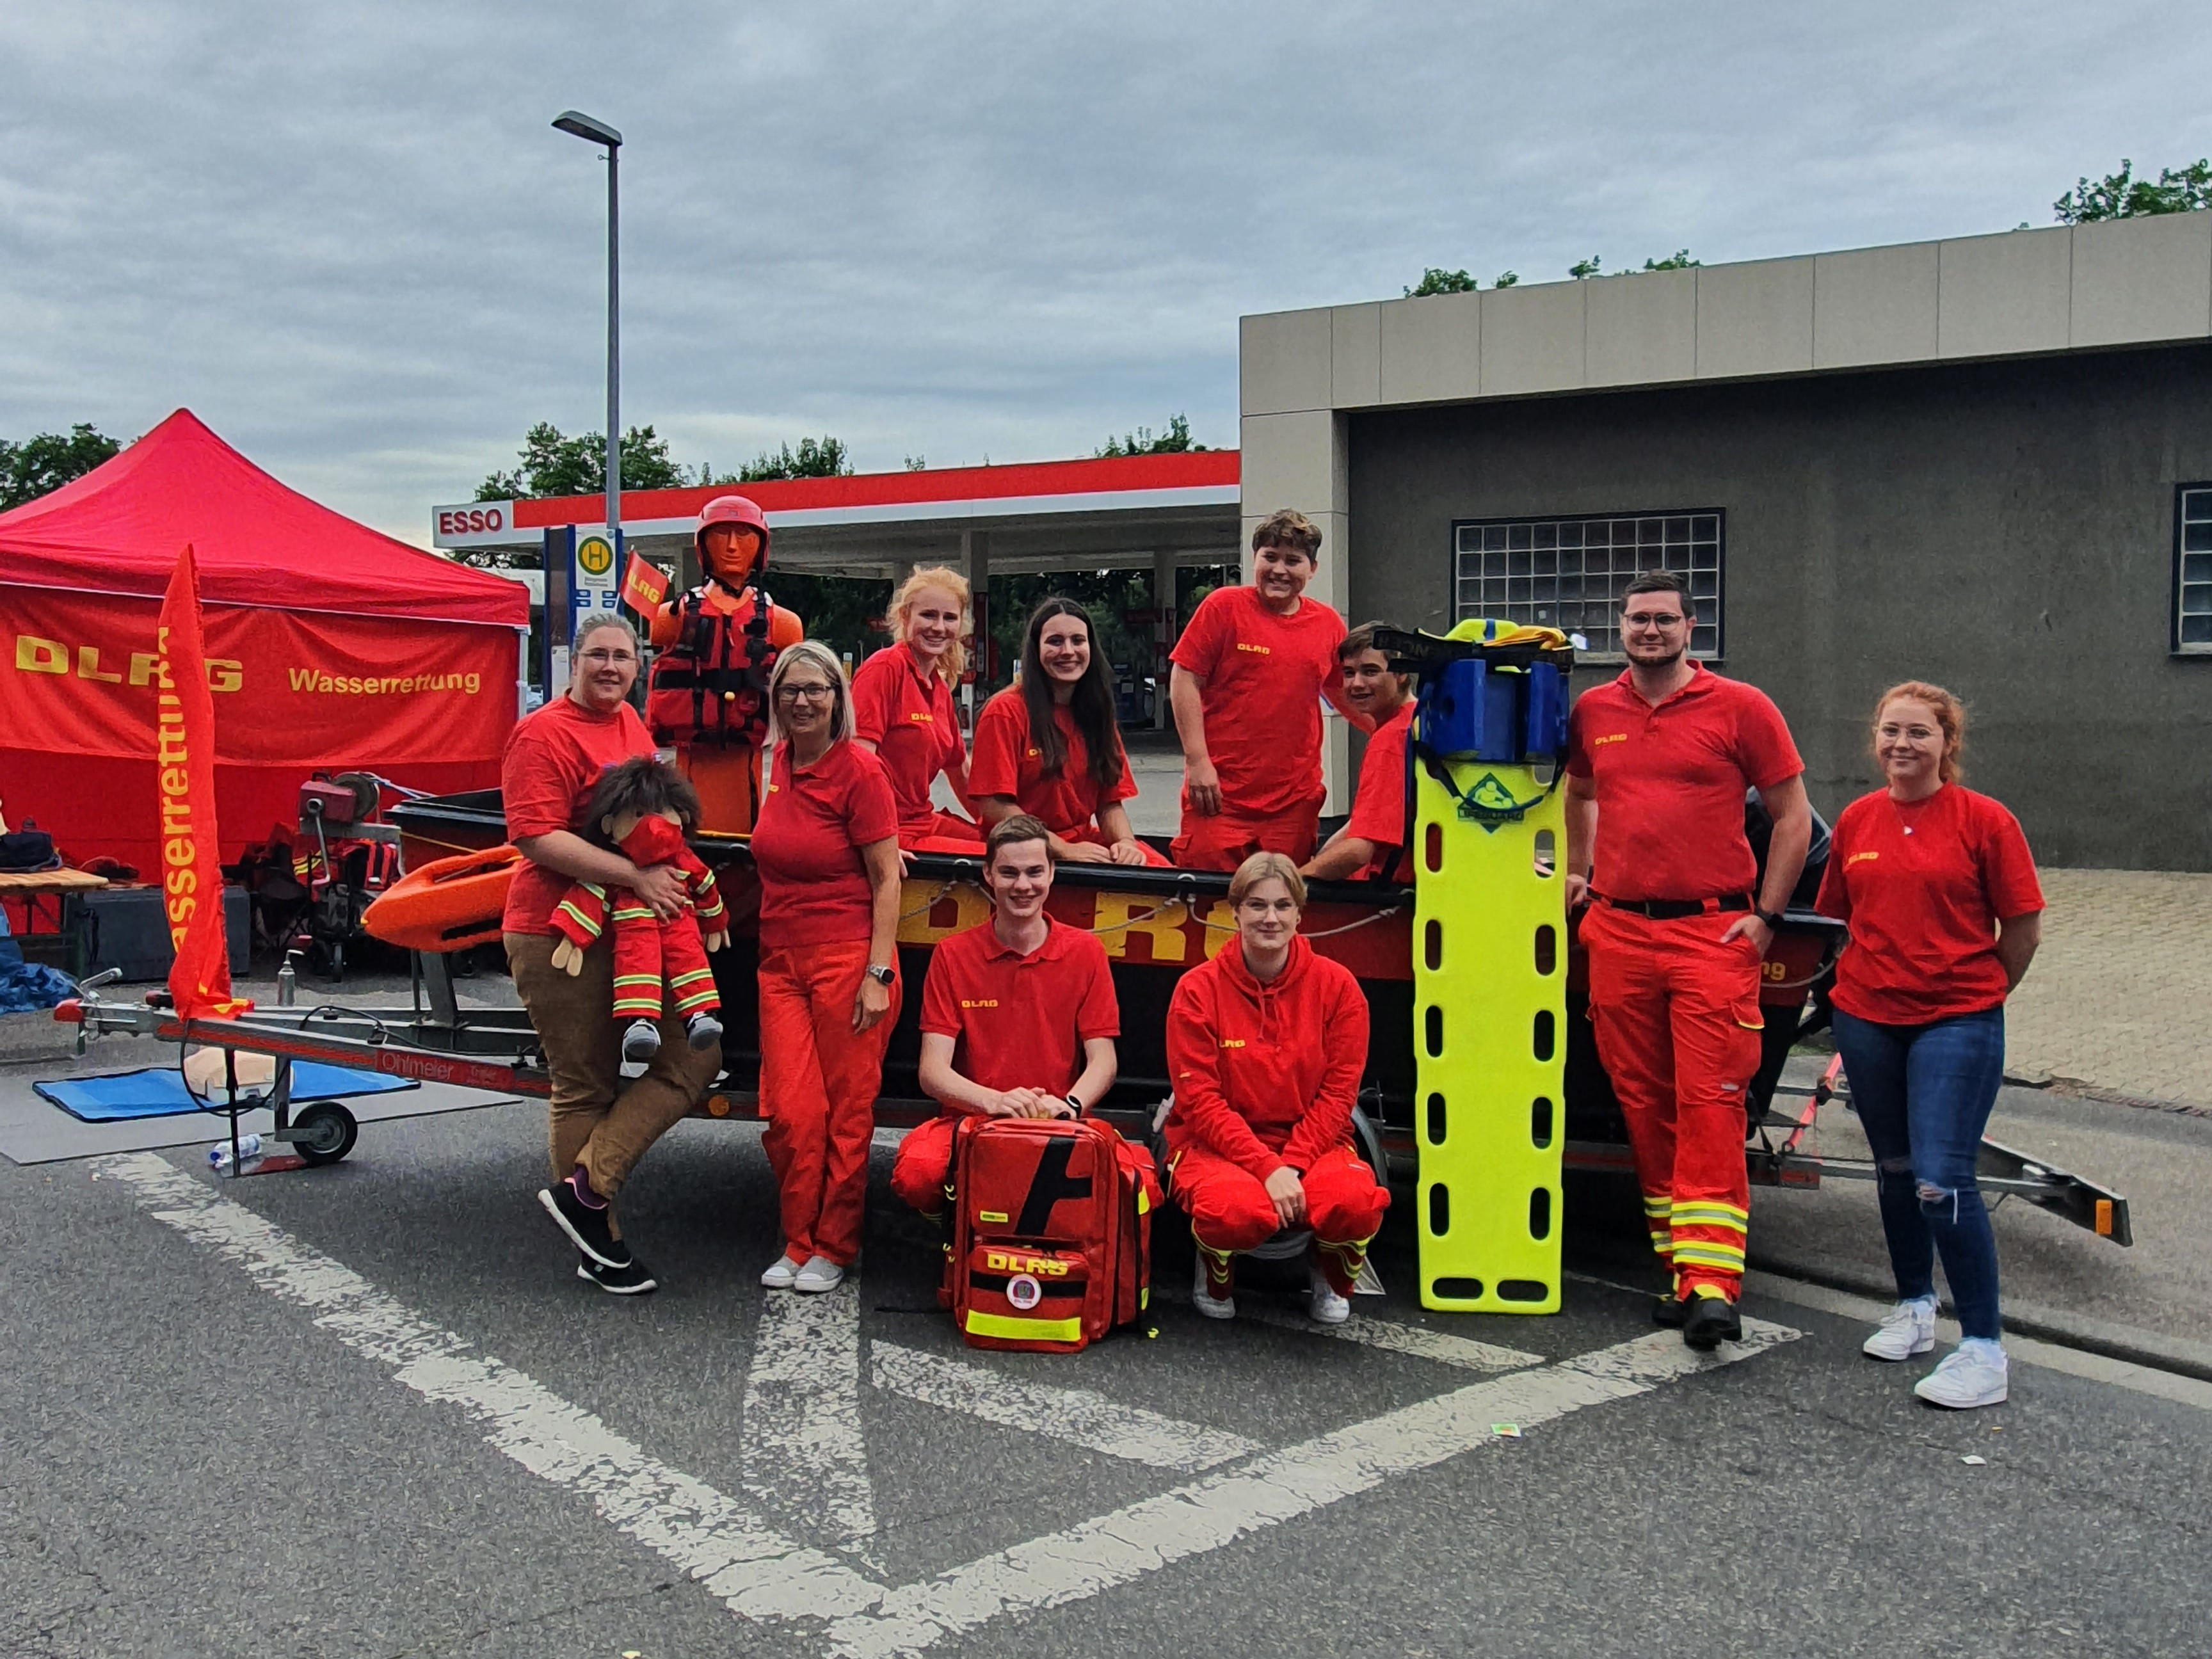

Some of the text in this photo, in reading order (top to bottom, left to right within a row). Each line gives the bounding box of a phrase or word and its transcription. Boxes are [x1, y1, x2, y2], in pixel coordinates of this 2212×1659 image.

[440, 509, 502, 534] ESSO
[589, 544, 602, 567] H
[289, 668, 480, 694] Wasserrettung
[1219, 1039, 1246, 1048] LRG
